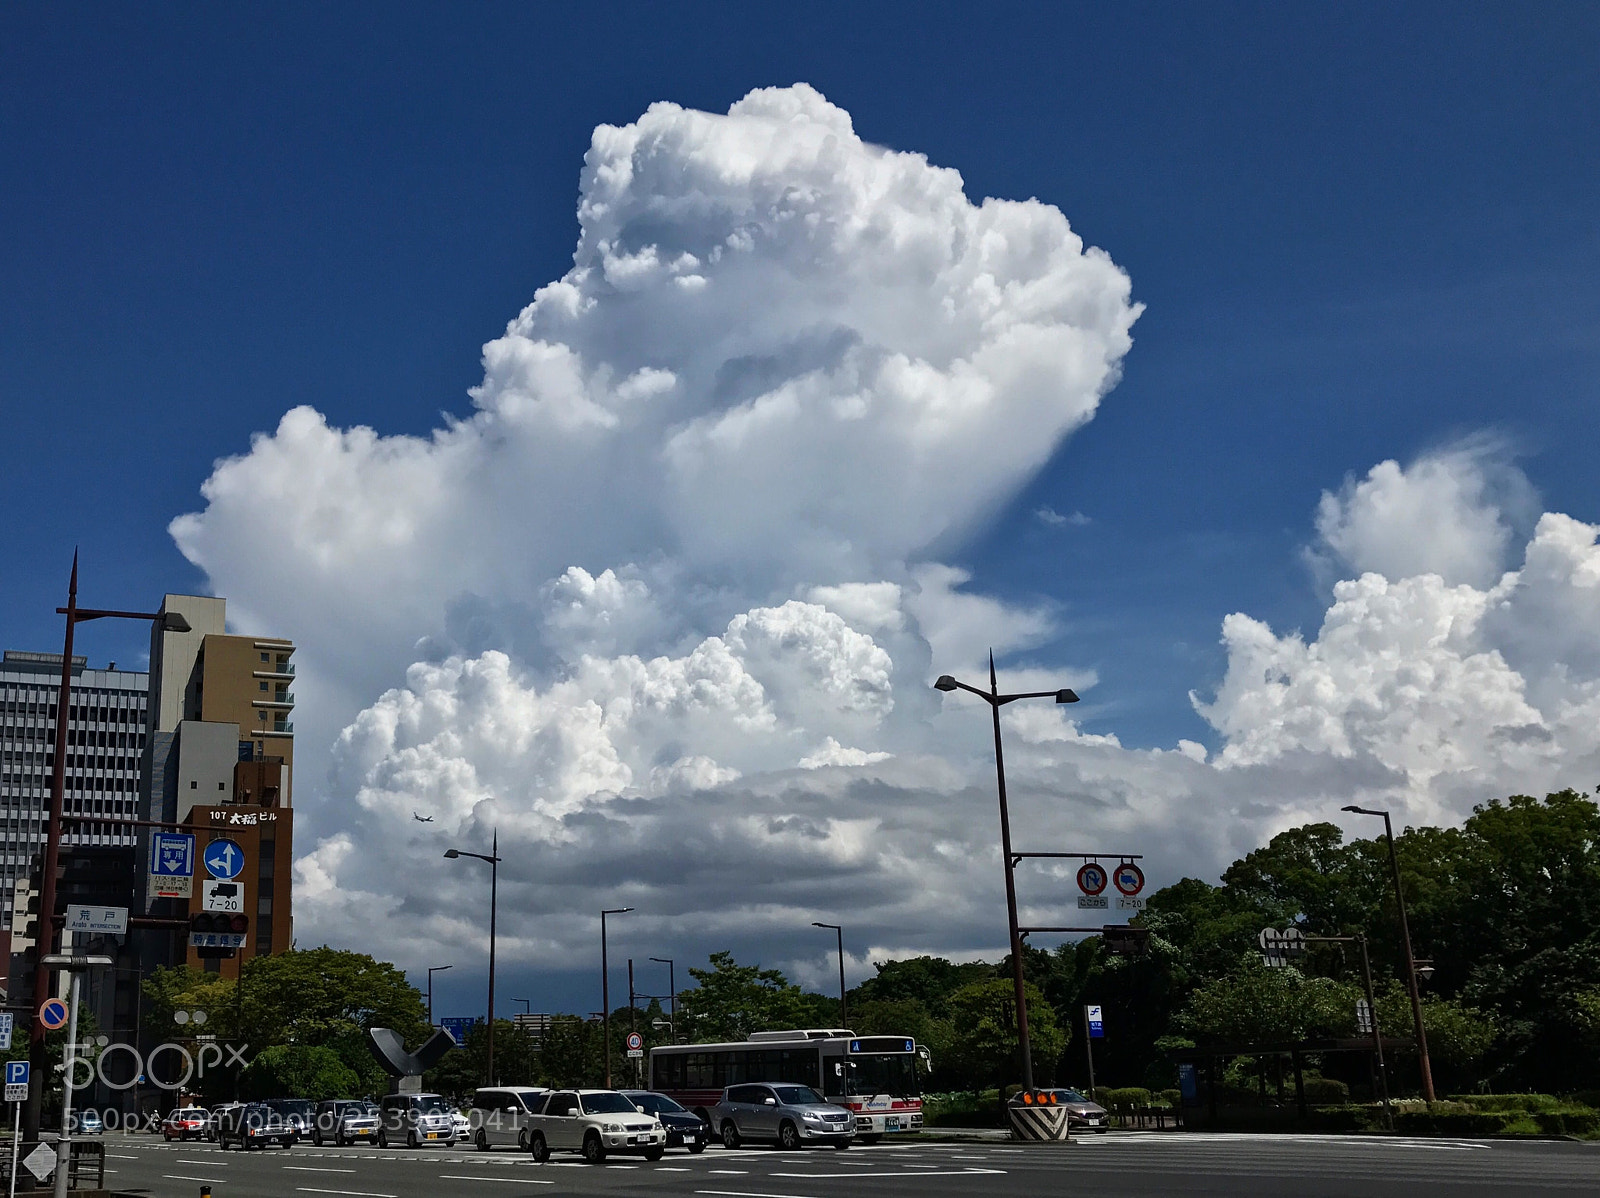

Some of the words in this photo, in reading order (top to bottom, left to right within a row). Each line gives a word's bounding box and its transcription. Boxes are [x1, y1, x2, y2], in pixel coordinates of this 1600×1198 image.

[210, 811, 227, 820] 107
[208, 899, 238, 911] 7-20
[1120, 899, 1142, 908] 7-20
[79, 910, 116, 921] 荒戸
[631, 1037, 640, 1046] 40
[12, 1064, 26, 1082] P
